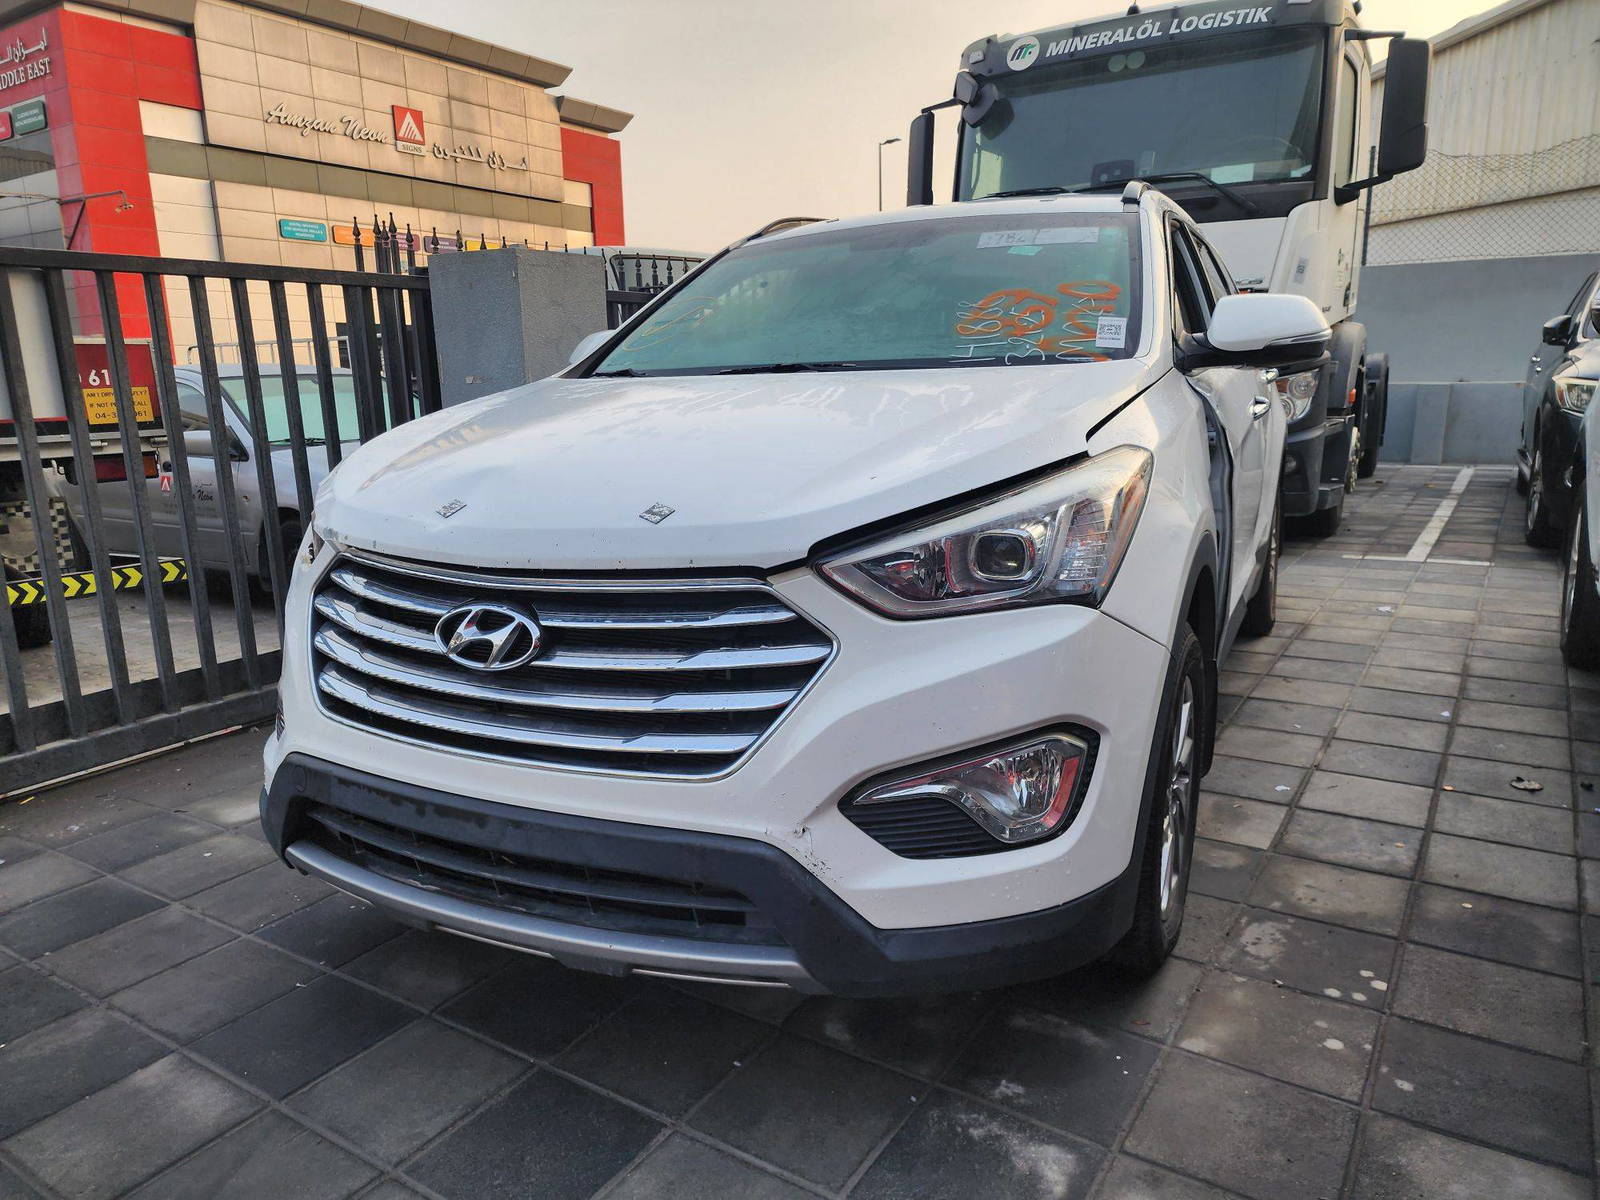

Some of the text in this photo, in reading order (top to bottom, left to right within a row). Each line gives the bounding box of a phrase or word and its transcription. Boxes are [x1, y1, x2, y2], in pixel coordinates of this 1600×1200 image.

[1045, 6, 1273, 58] MINERALÖL LOGISTIK
[0, 57, 51, 90] DDLE EAST
[266, 102, 389, 143] Amzan Neon
[400, 143, 422, 155] SIGNS
